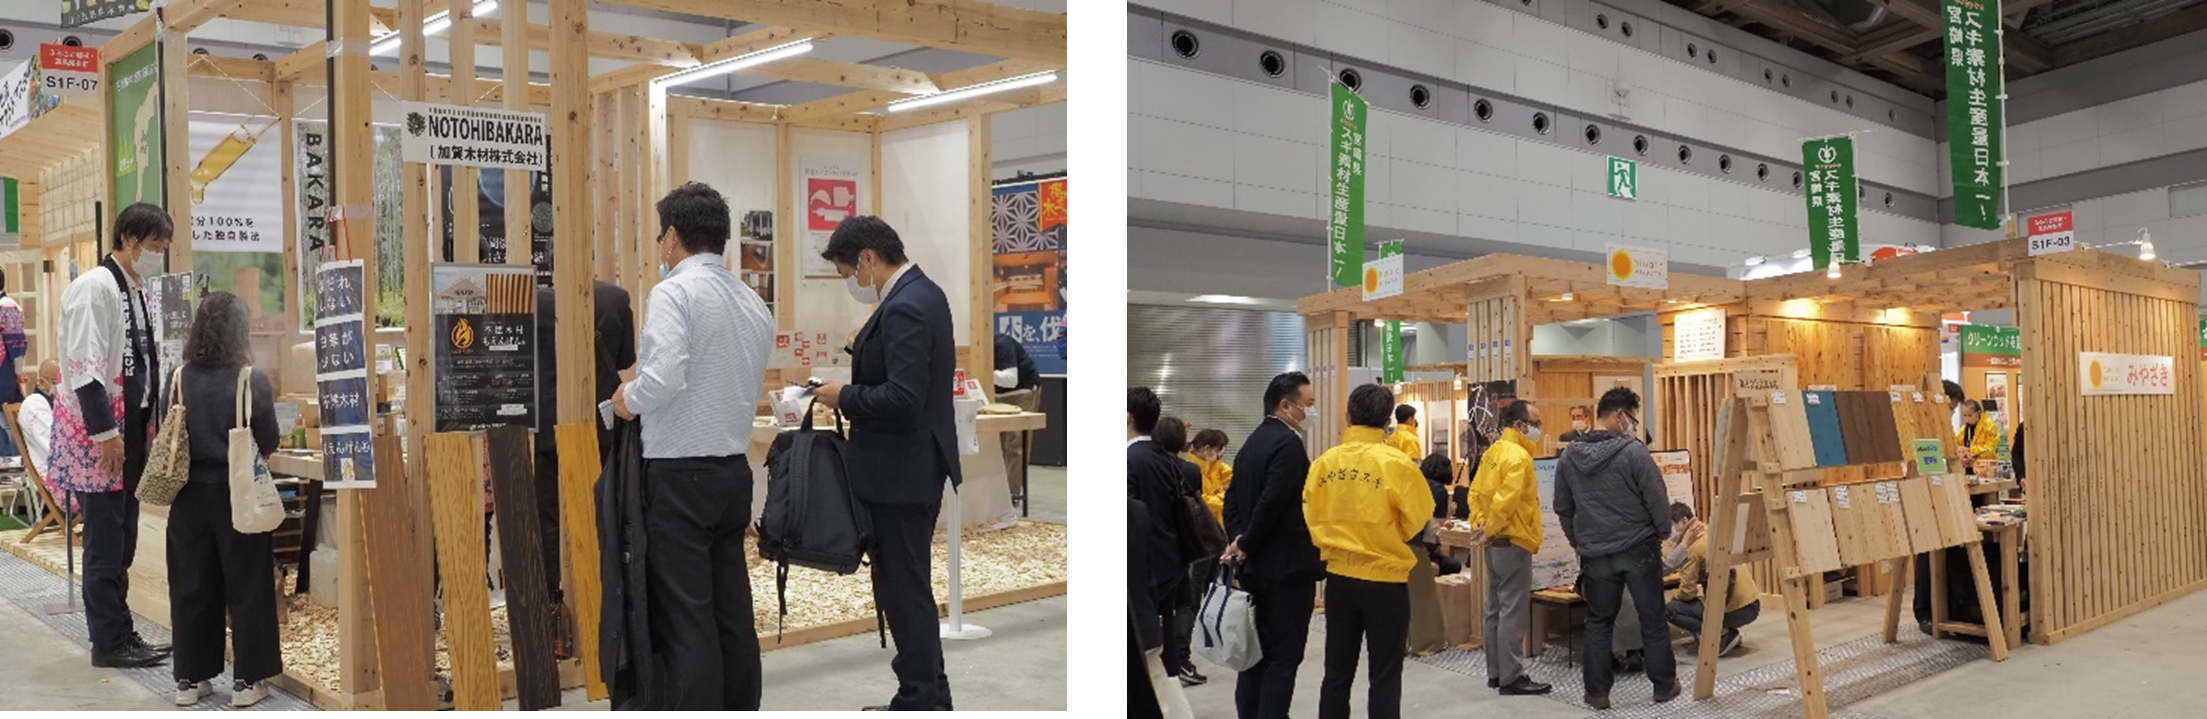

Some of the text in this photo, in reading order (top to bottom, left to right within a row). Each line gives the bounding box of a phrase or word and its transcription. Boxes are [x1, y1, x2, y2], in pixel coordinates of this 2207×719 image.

[46, 75, 98, 91] S1F-07
[428, 115, 543, 146] NOTOHIBAKARA
[304, 132, 325, 252] BAKARA
[190, 215, 254, 228] 分100%を
[2032, 236, 2070, 251] S1F-03
[2126, 363, 2168, 387] みやざき
